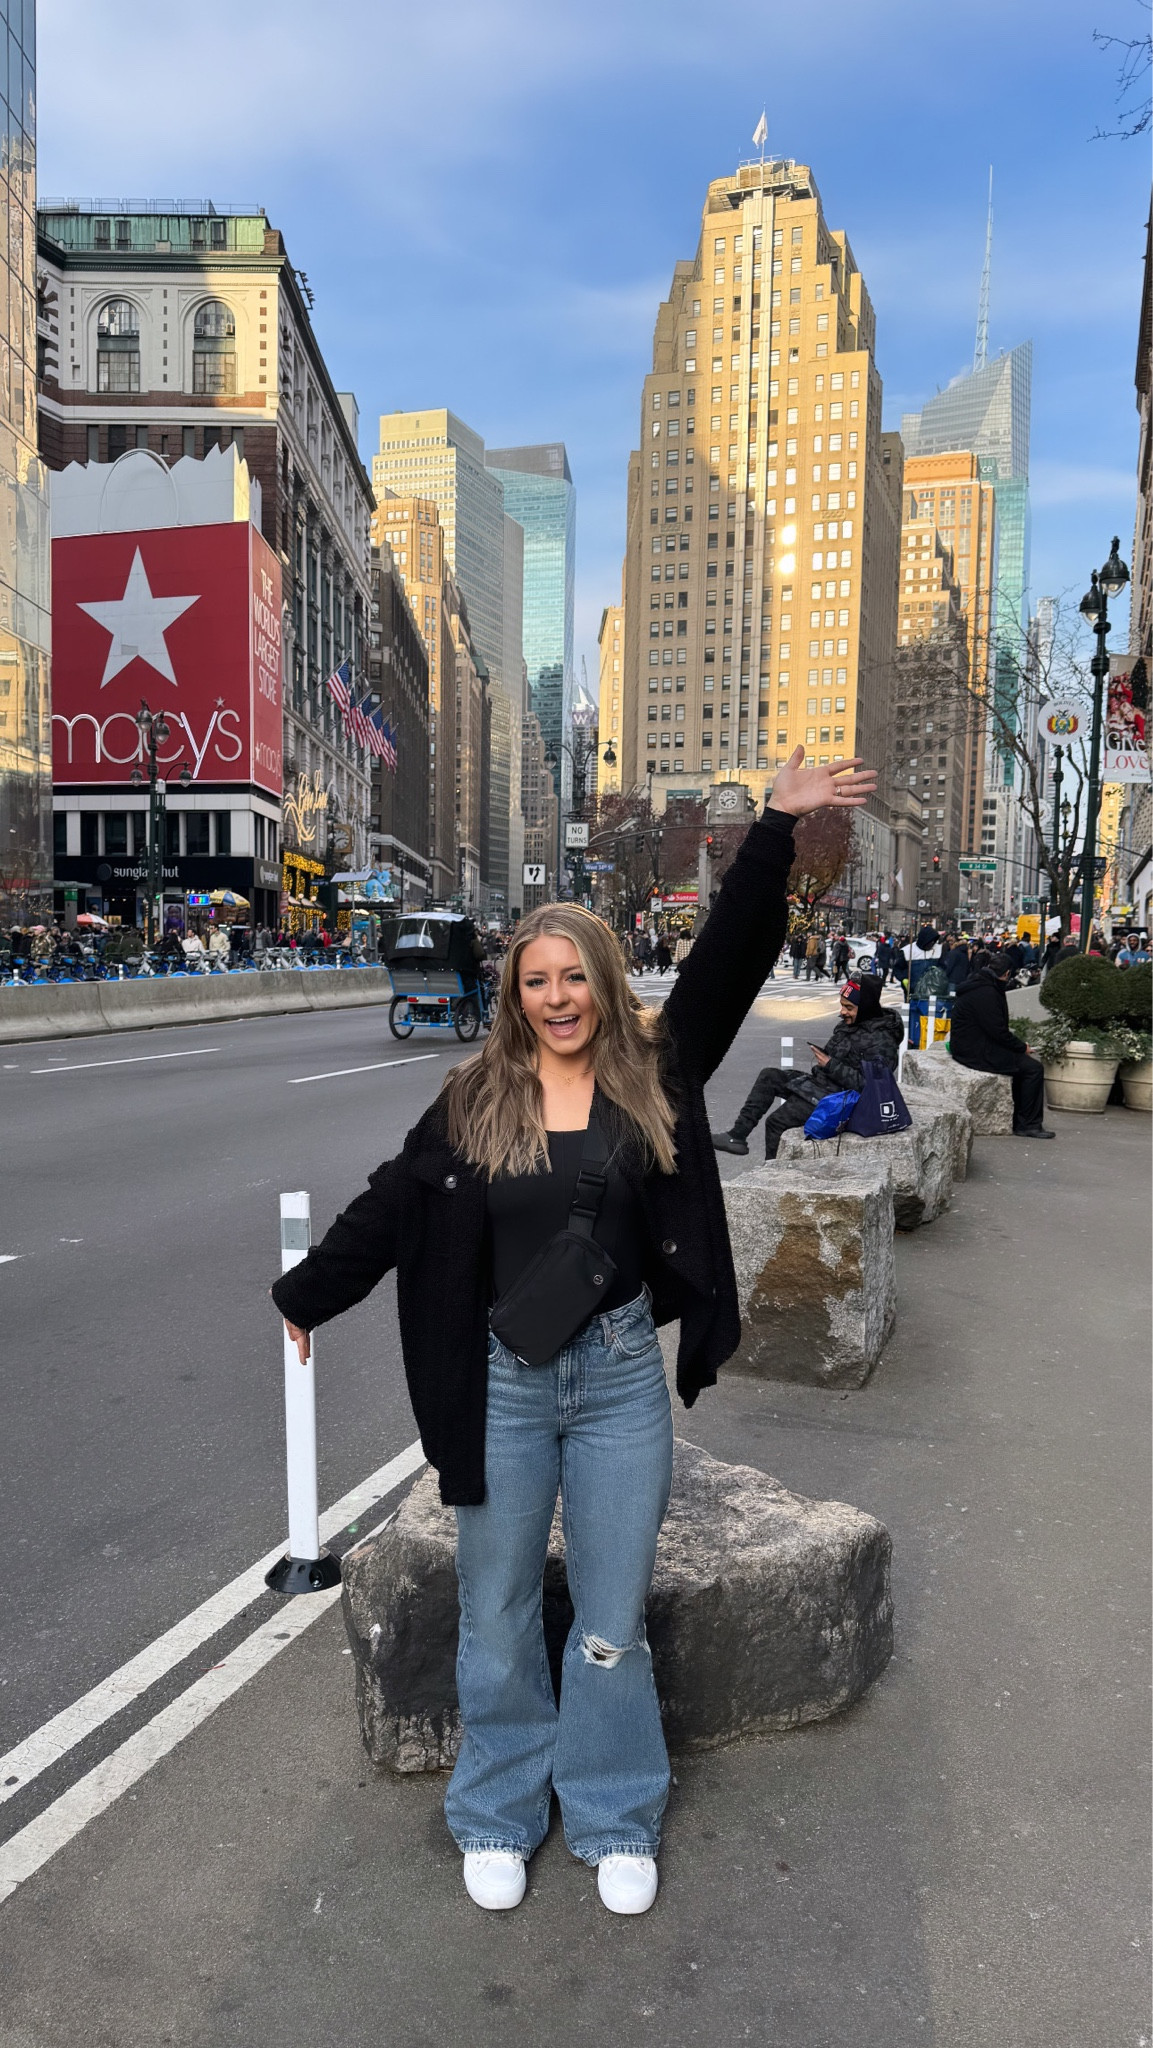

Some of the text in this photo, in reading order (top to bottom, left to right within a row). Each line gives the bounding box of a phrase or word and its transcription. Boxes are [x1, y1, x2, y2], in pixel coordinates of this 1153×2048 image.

[261, 568, 273, 607] THE
[254, 626, 280, 676] LARGEST
[259, 665, 277, 705] STORE
[573, 714, 588, 725] W
[1106, 732, 1146, 752] Give
[1104, 750, 1149, 769] Love
[571, 826, 583, 834] NO
[113, 865, 179, 880] sungla hut
